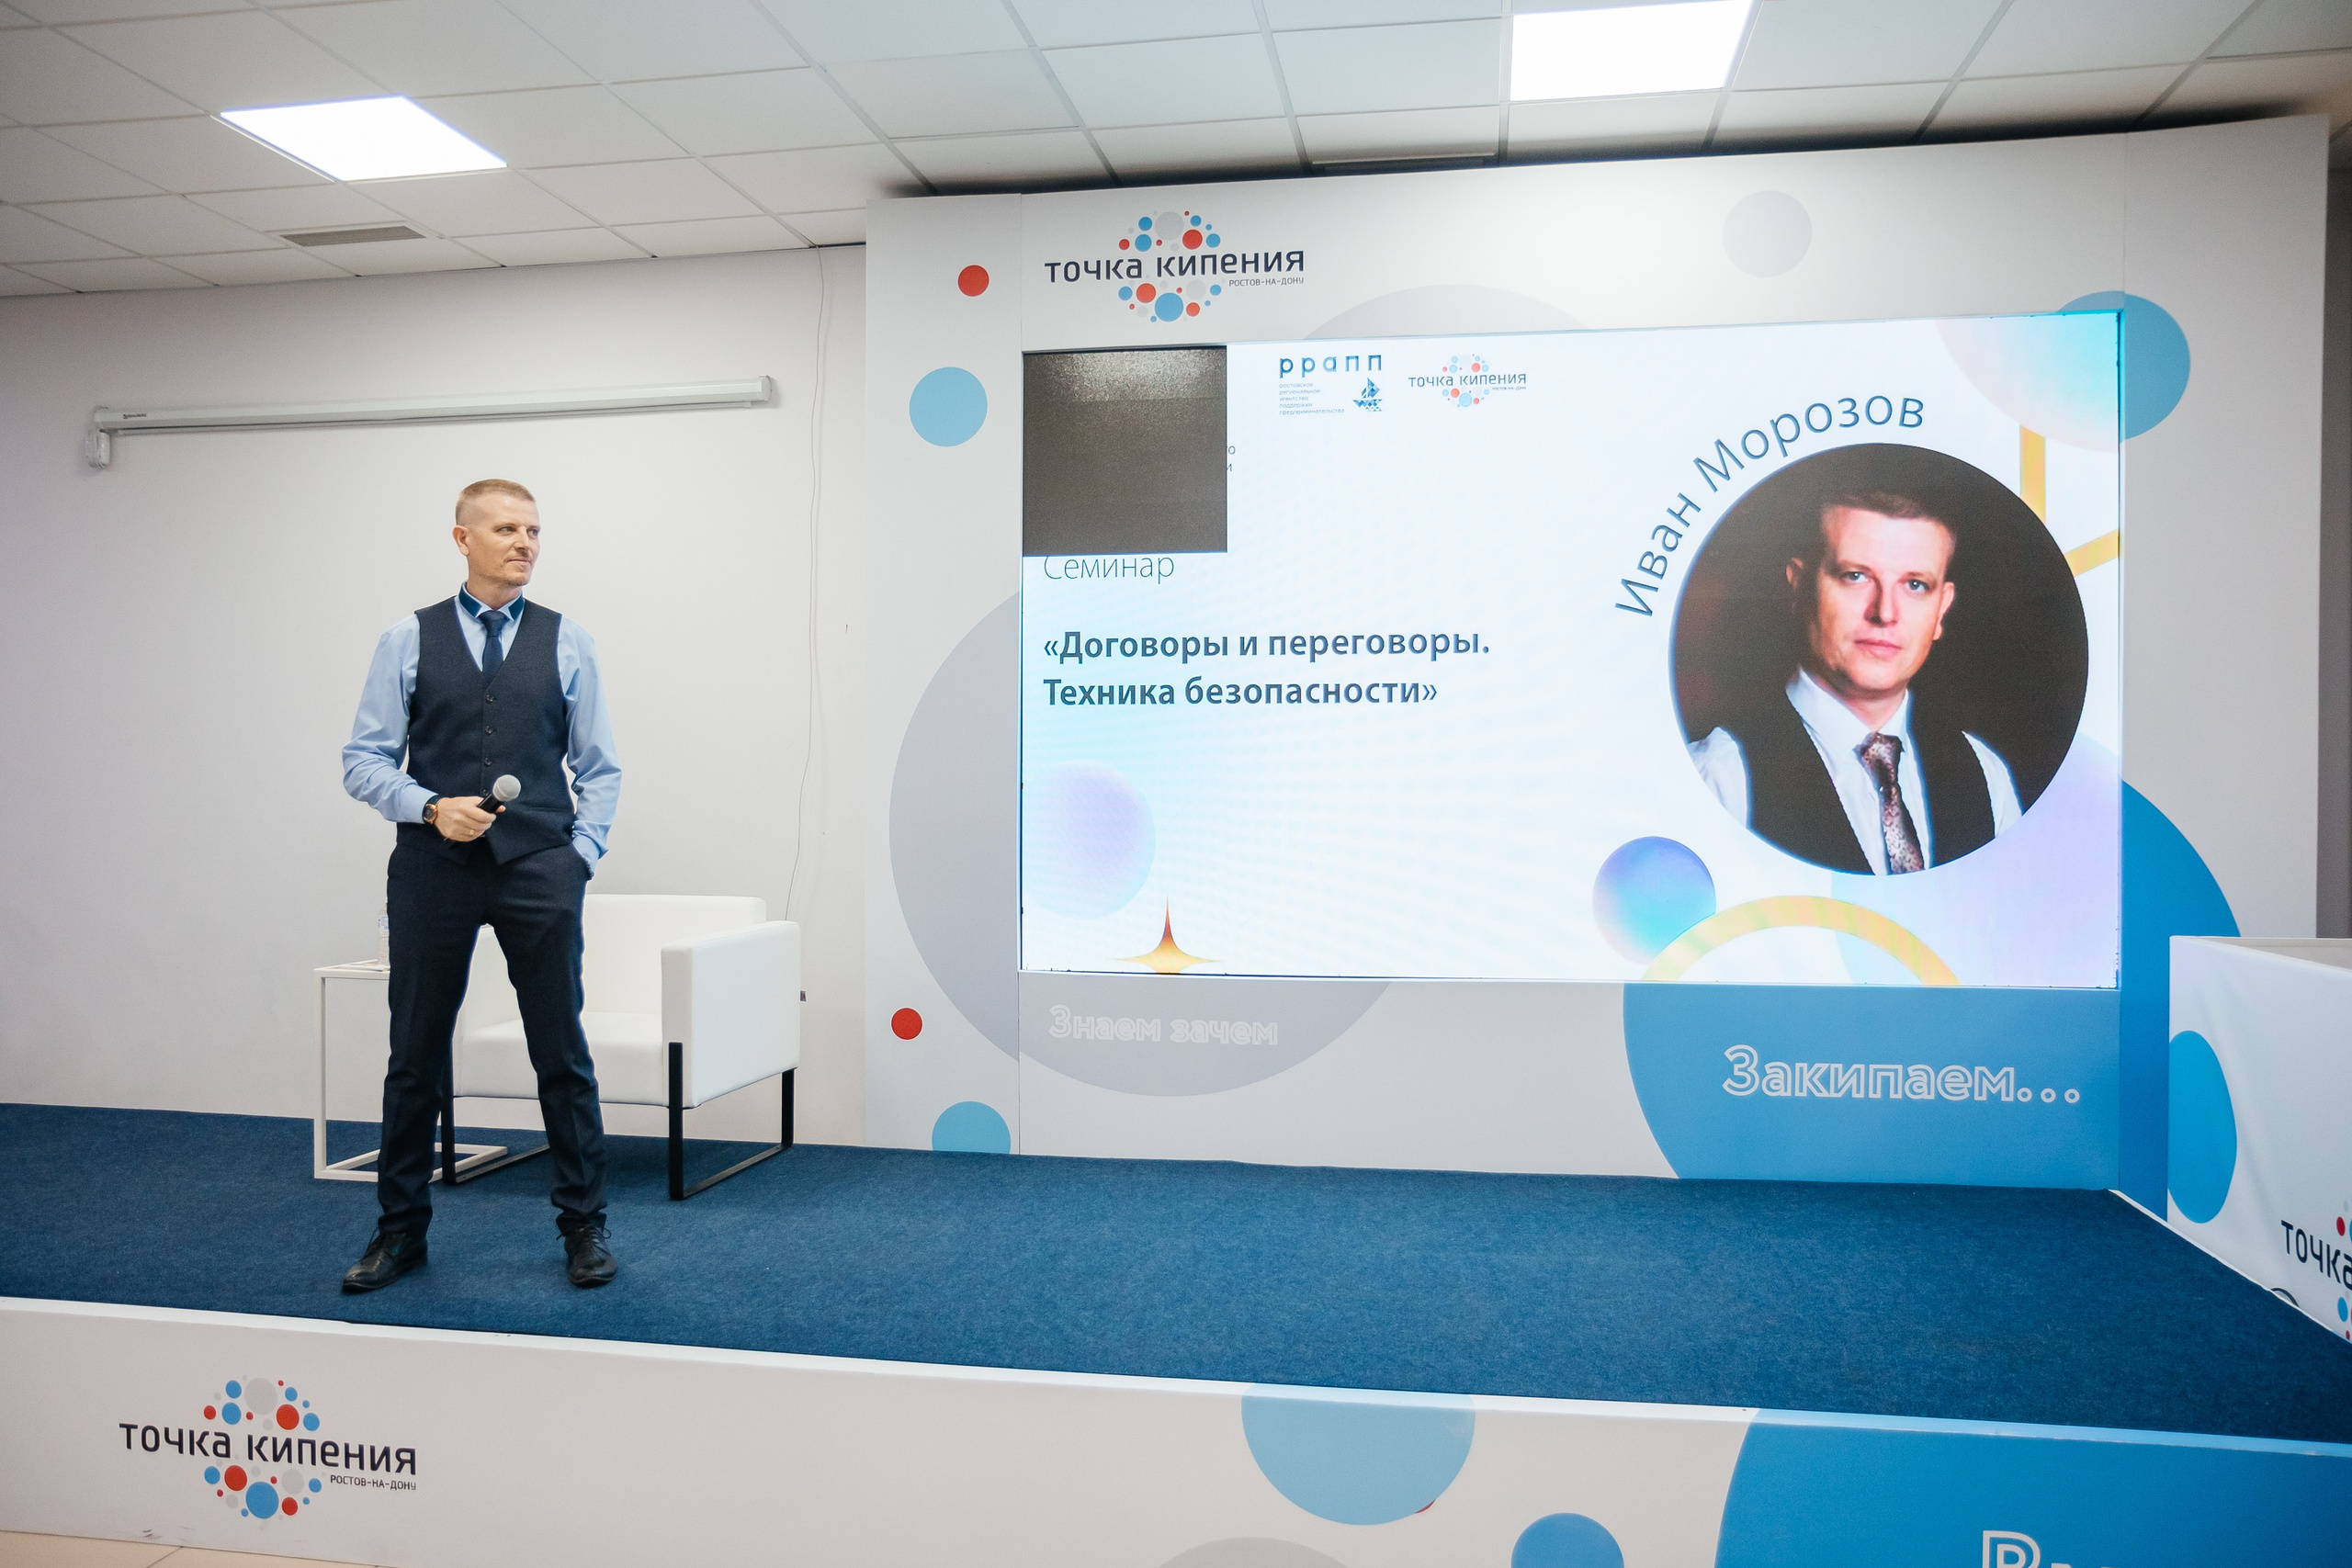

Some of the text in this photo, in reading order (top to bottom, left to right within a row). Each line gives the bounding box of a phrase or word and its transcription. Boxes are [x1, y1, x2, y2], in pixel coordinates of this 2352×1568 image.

[1044, 250, 1305, 283] точка кипения
[1228, 276, 1305, 288] РОСТОВ-НА-ДОНУ
[1408, 373, 1527, 387] точка кипения
[1614, 395, 1925, 616] Иван Морозов
[1044, 555, 1175, 584] Семинар
[1043, 631, 1490, 664] «Договоры и переговоры.
[1043, 676, 1437, 705] Техника безопасности»
[1048, 1004, 1278, 1045] Знаем зачем
[1722, 1044, 2081, 1103] Закипаем...
[119, 1423, 417, 1475] точка кипения
[330, 1474, 417, 1491] РОСТОВ-НА-ДОНУ
